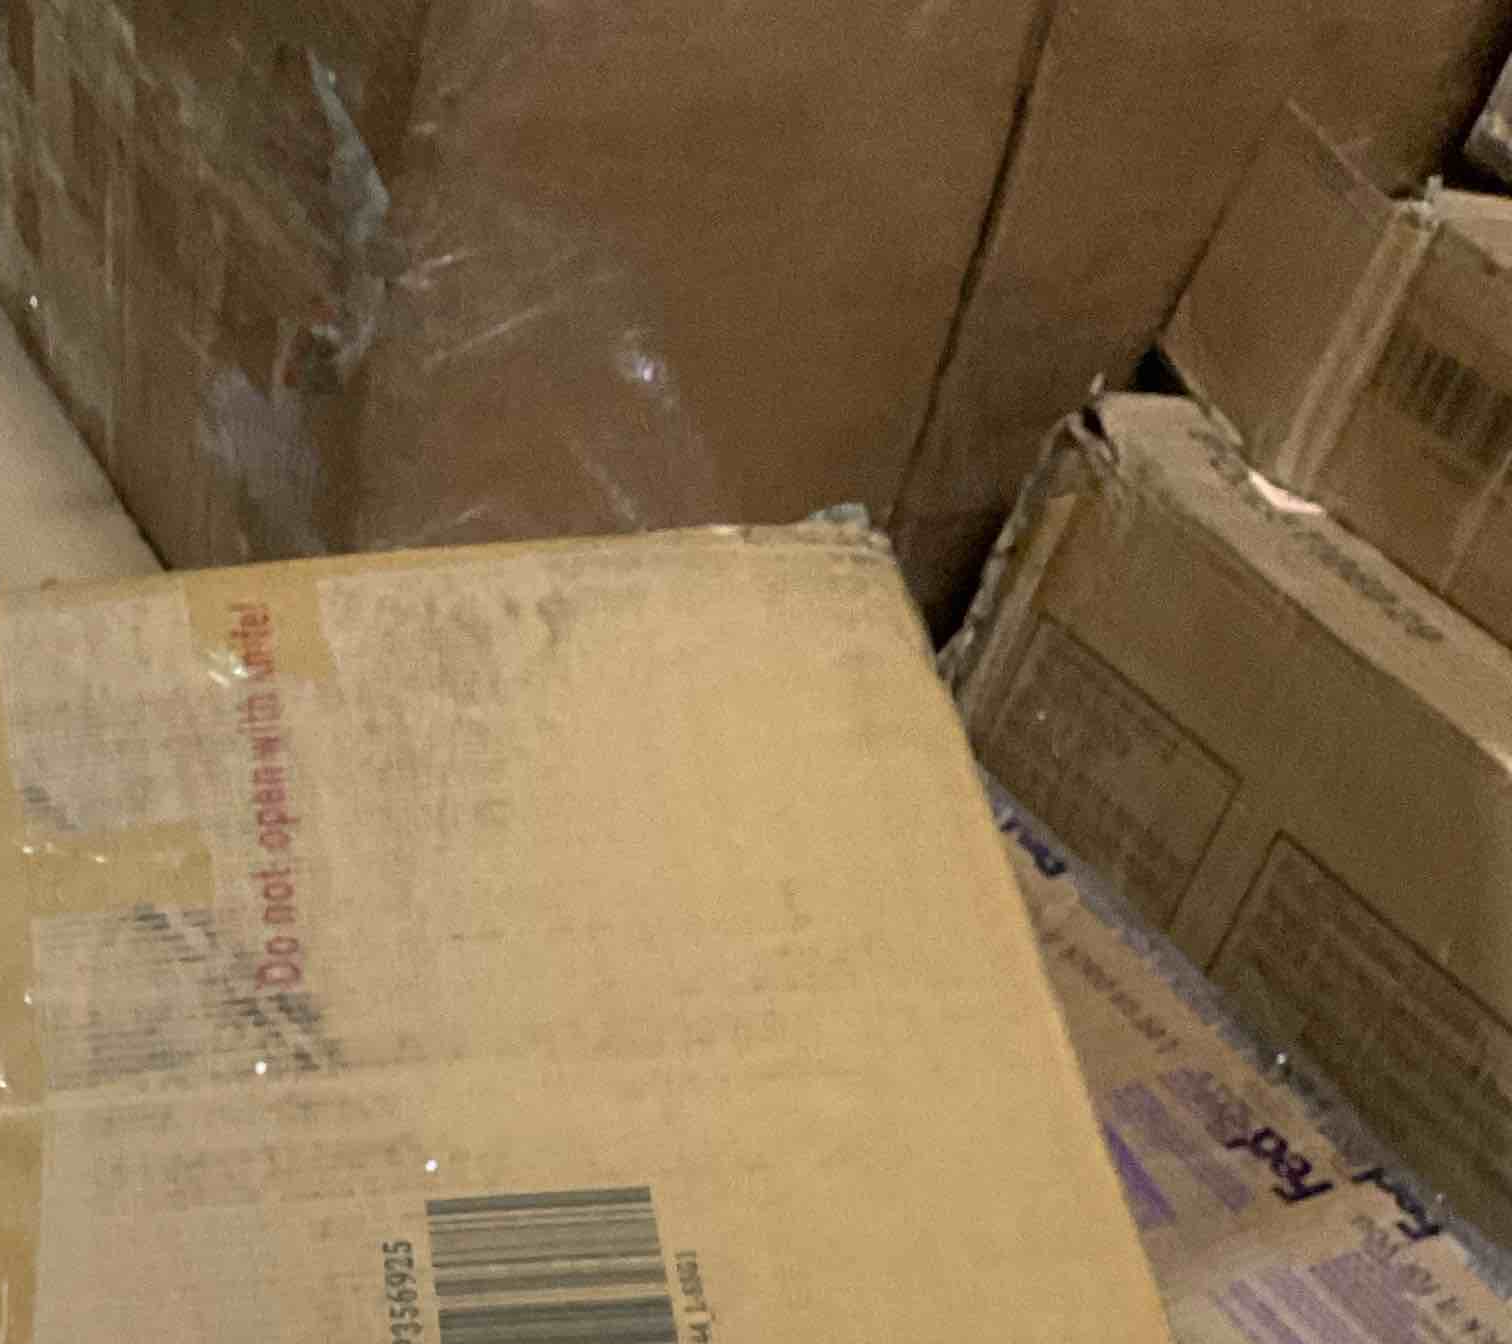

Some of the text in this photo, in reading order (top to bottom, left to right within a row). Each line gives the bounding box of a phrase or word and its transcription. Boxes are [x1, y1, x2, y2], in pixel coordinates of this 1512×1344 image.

[236, 693, 281, 761] with
[251, 767, 300, 851] open
[252, 868, 296, 924] not
[254, 934, 302, 990] Do
